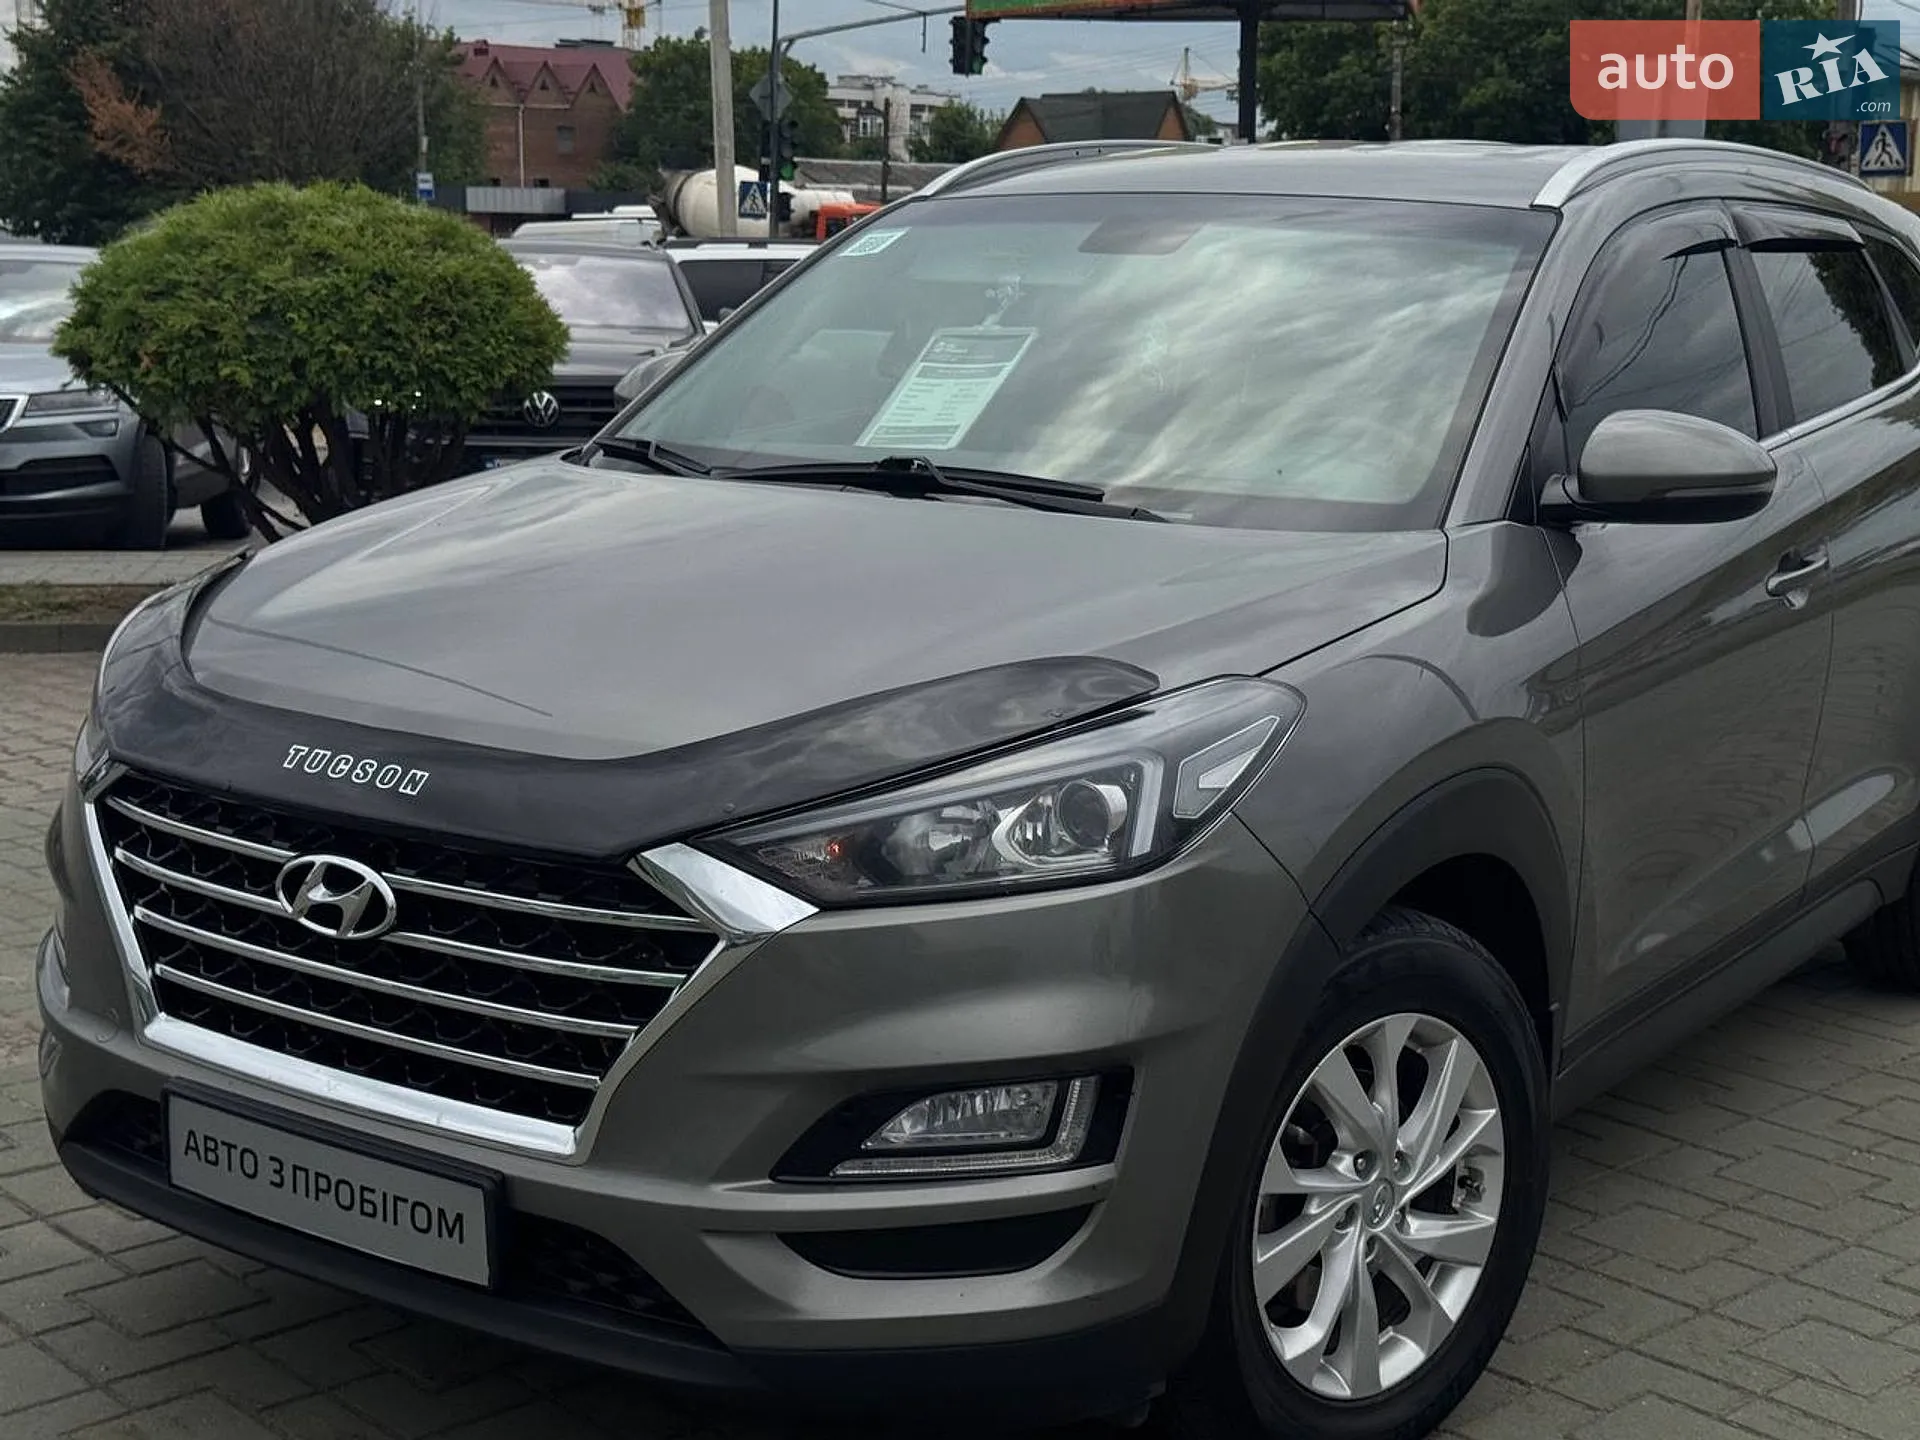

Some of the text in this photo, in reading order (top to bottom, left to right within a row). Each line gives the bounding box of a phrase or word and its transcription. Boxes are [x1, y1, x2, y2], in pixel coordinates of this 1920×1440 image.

[283, 744, 429, 795] TUCSON
[184, 1129, 465, 1245] АВТО З ПРОБІГОМ
